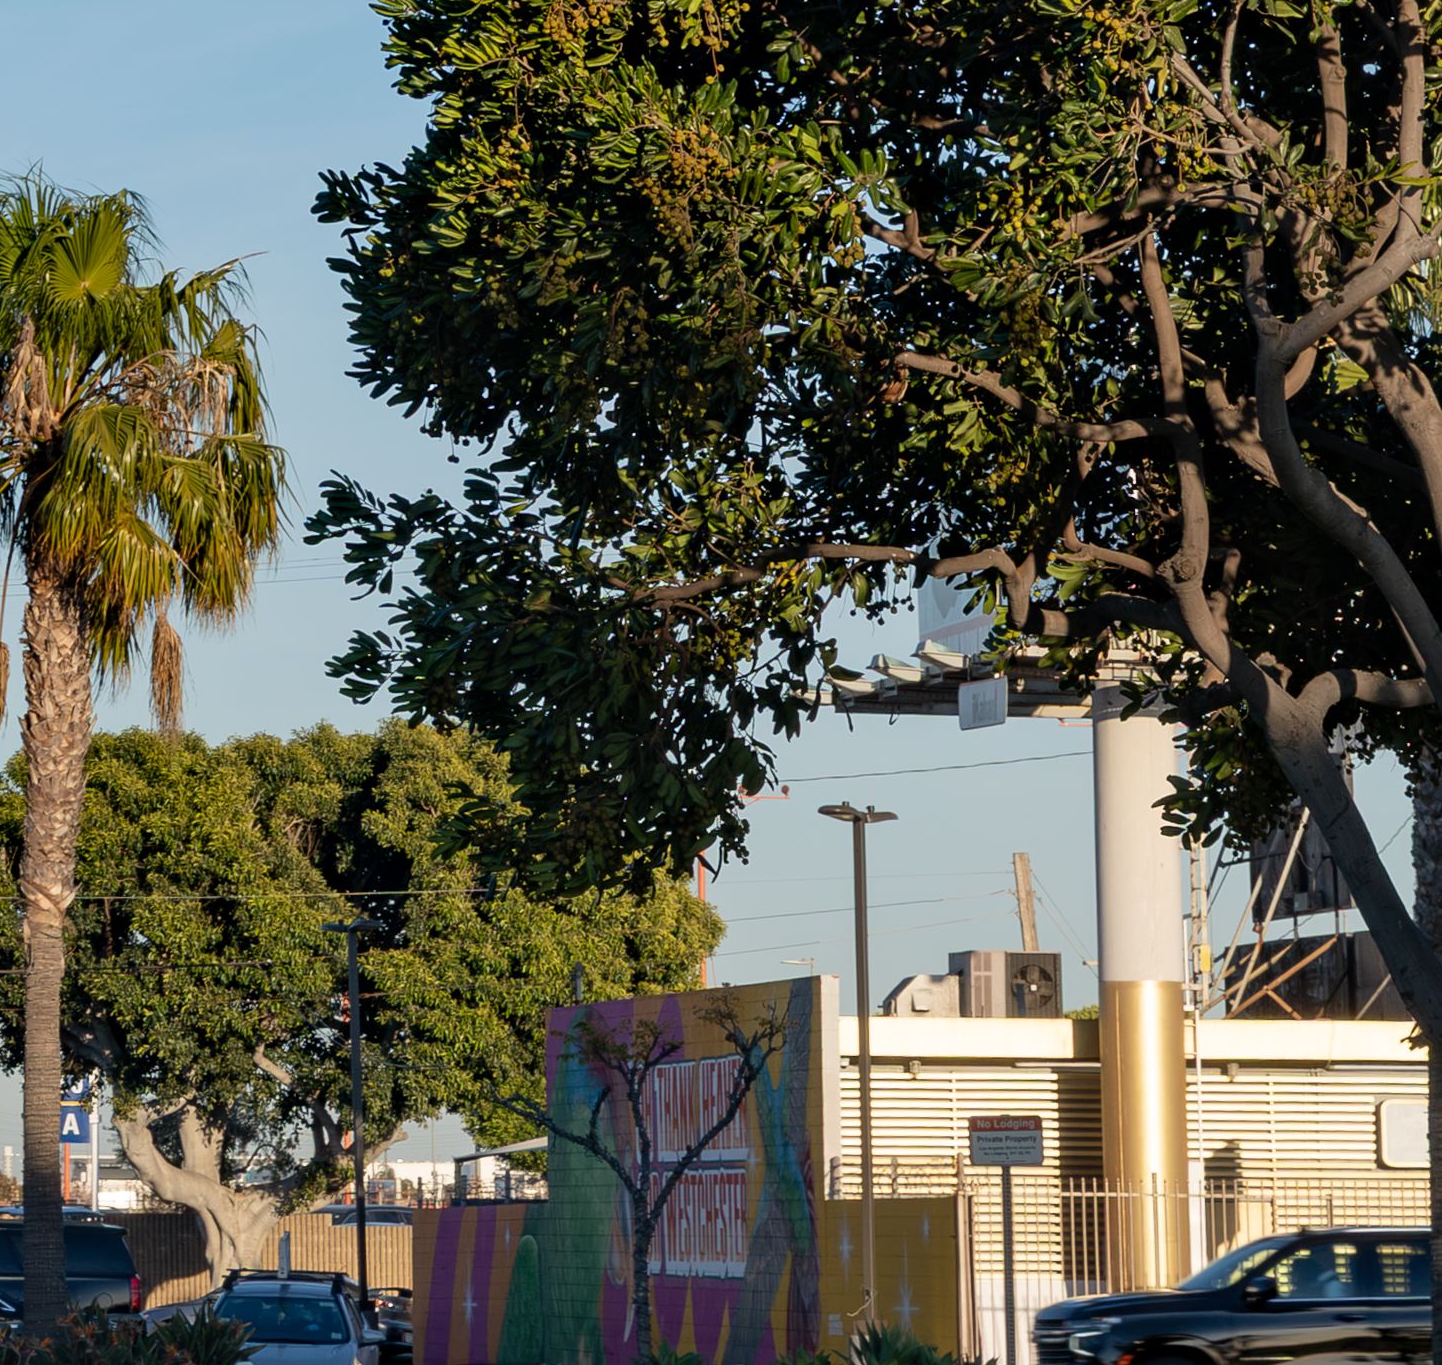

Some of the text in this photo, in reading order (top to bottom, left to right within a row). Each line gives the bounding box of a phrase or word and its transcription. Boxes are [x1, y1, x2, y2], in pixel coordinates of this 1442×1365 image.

[654, 1060, 698, 1161] THANK
[977, 1119, 1035, 1130] No Lodging
[1004, 1135, 1036, 1144] Property
[663, 1167, 748, 1278] WESTCHESTER
